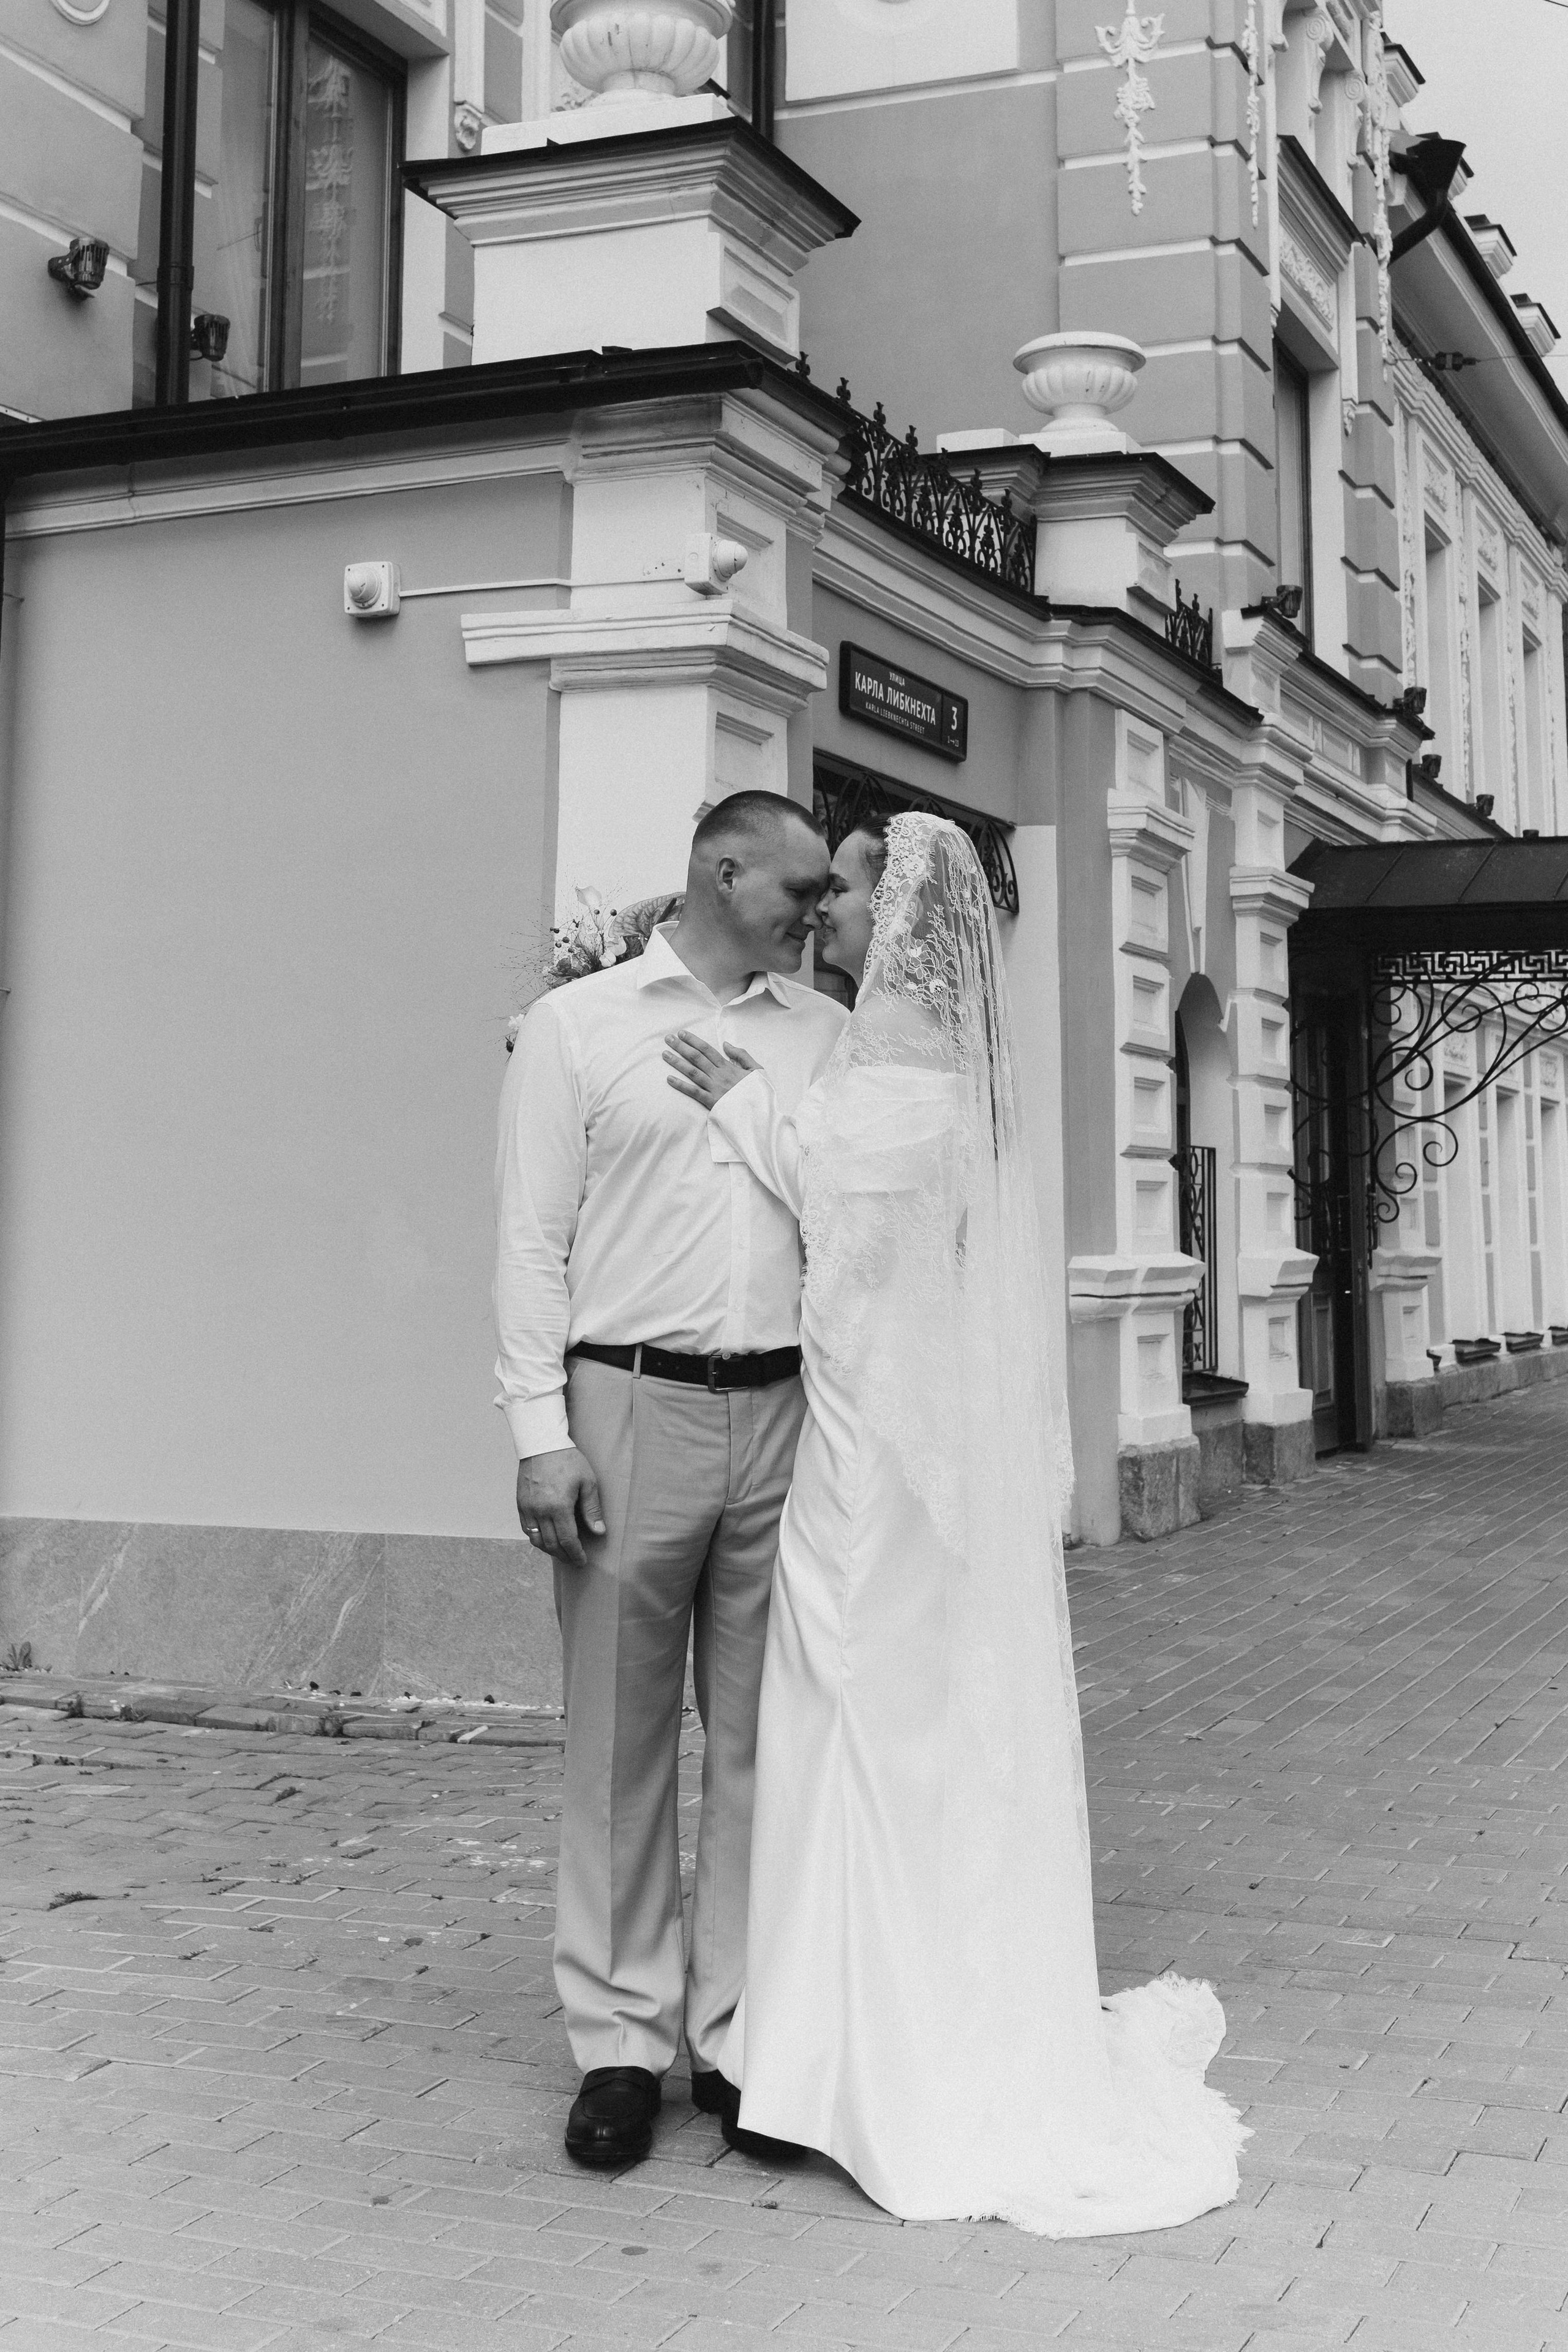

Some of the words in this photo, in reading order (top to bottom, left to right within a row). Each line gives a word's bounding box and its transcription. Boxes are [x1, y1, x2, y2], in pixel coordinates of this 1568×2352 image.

[889, 672, 905, 687] УЛИЦА
[855, 672, 884, 701] КАРЛА
[886, 687, 936, 725] ЛИБКНЕХТА
[865, 702, 880, 714] KARLA
[880, 708, 910, 727] LIEBKNECHTA
[910, 722, 925, 734] STREET
[951, 706, 957, 730] 3
